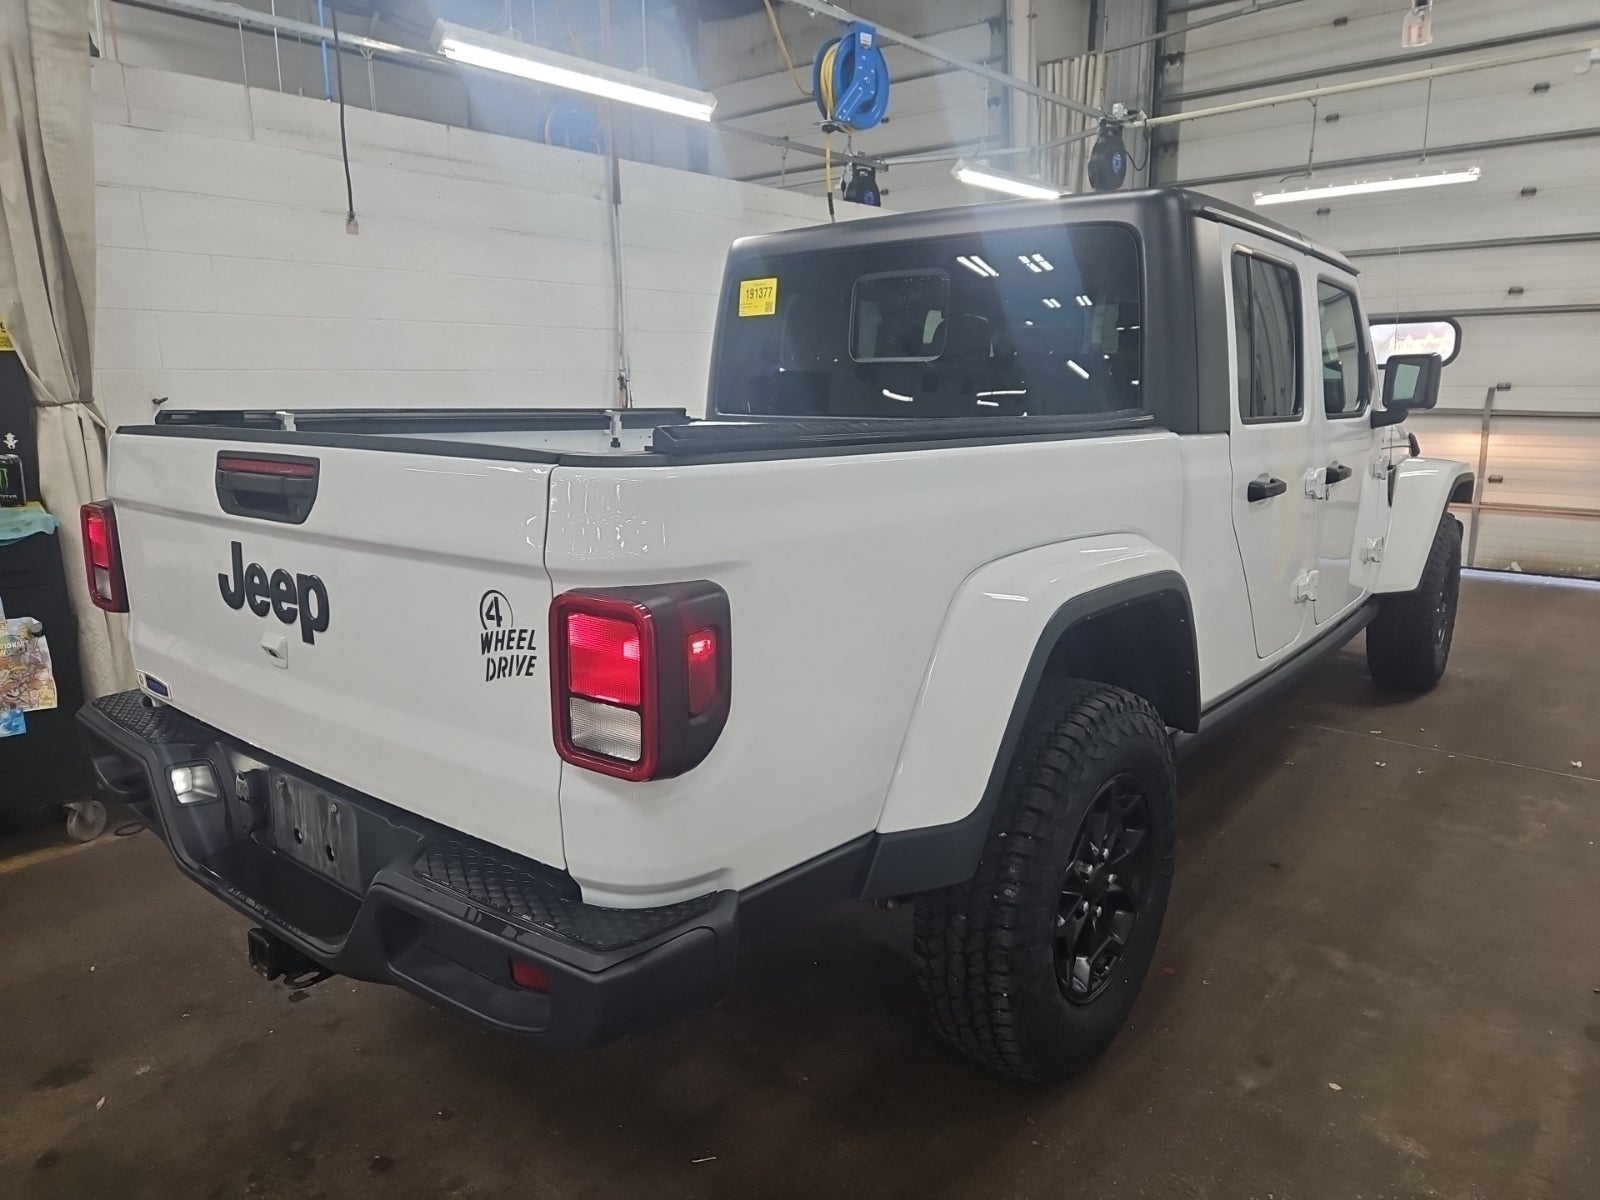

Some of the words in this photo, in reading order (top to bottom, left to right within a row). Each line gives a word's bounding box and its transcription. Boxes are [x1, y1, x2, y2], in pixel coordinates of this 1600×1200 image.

[746, 286, 773, 299] 191377
[218, 541, 330, 645] Jeep
[485, 596, 503, 627] 4
[481, 629, 536, 655] WHEEL
[486, 655, 537, 682] DRIVE
